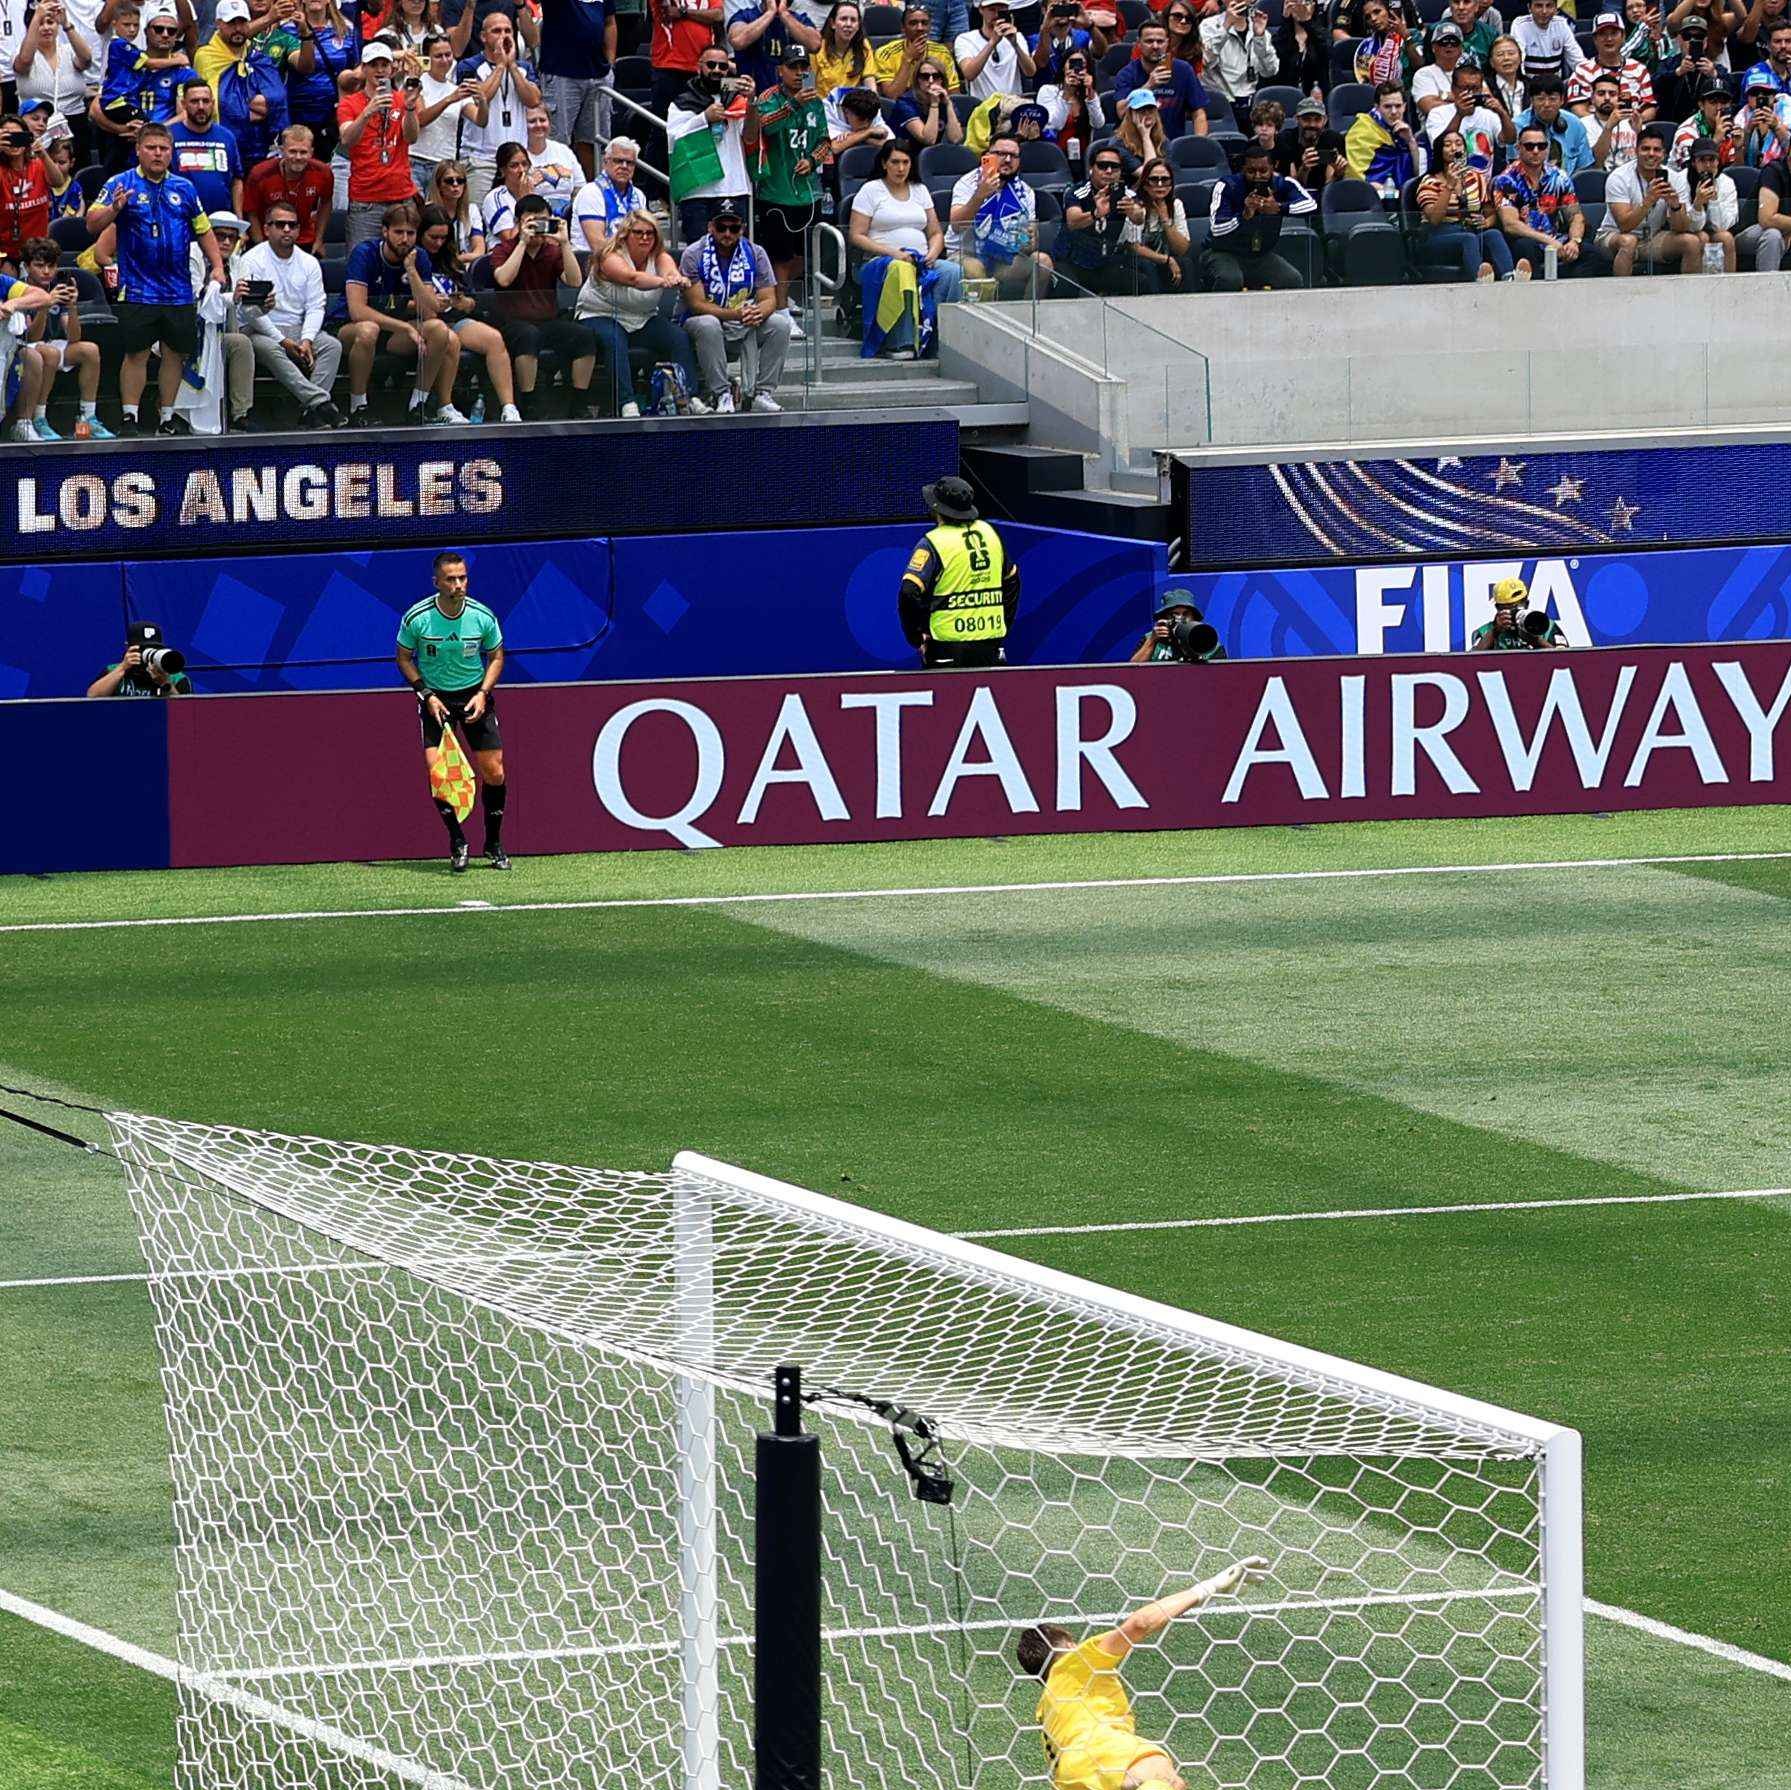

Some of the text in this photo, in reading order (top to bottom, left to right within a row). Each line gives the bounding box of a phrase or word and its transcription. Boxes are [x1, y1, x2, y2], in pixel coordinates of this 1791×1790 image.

[16, 458, 504, 533] LOS ANGELES
[1354, 559, 1593, 655] FIFA
[592, 684, 1151, 849] QATAR
